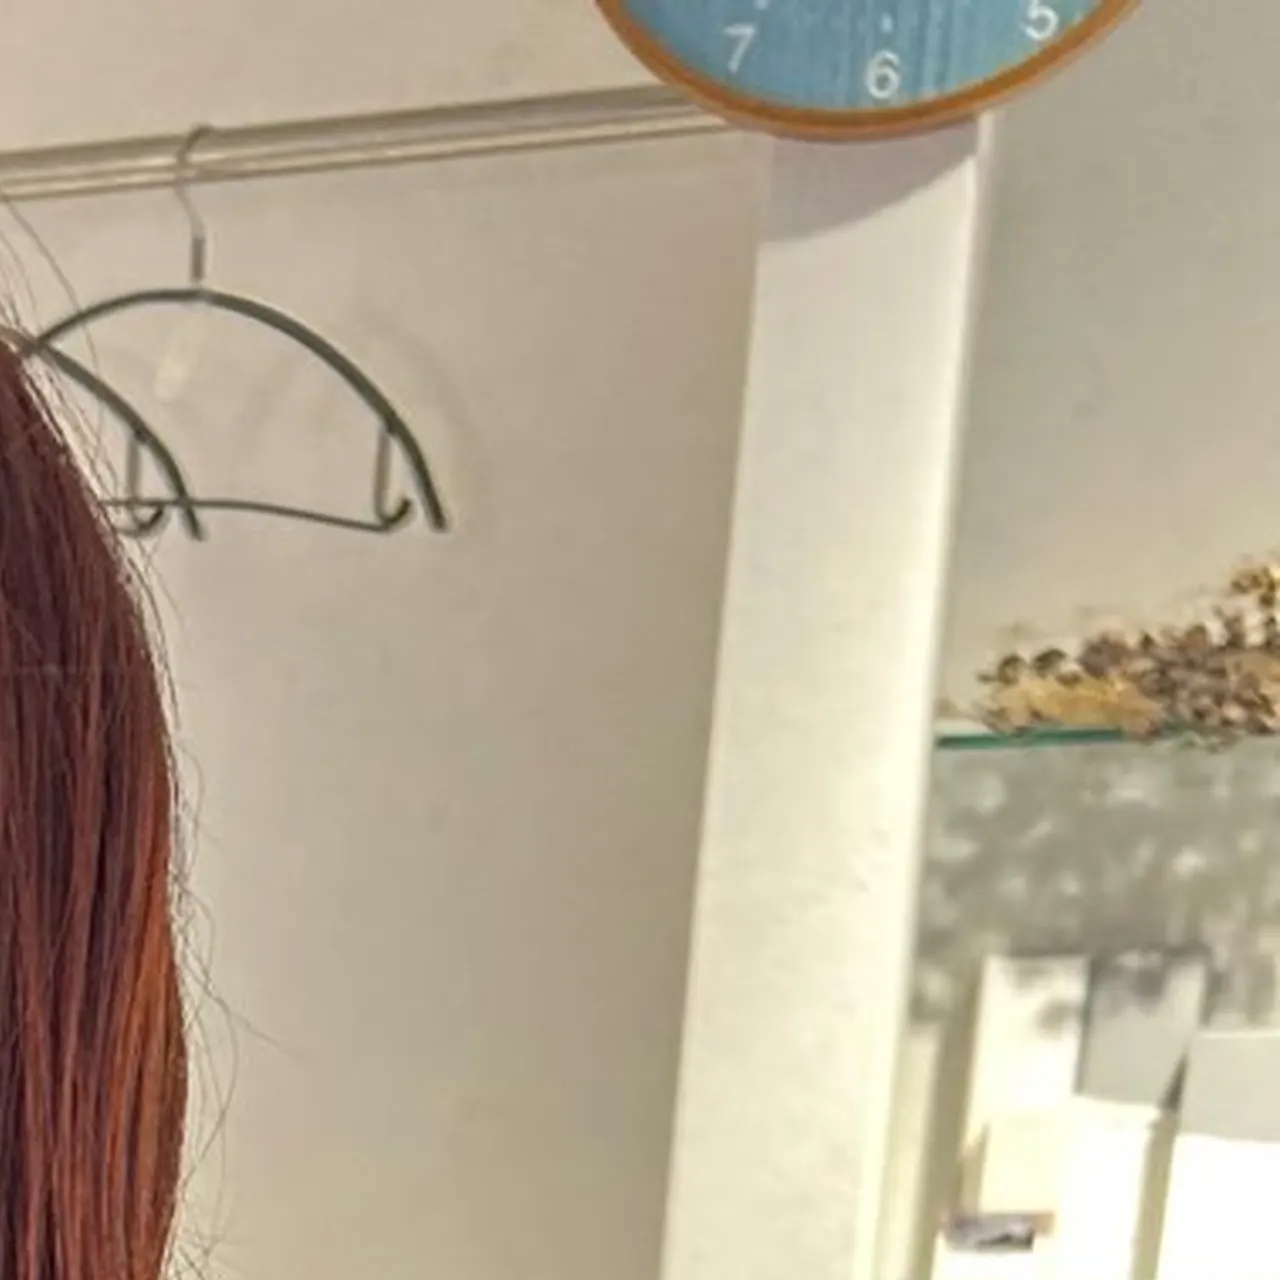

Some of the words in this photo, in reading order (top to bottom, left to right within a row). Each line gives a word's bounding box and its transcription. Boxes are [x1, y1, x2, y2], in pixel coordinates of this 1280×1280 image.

[1024, 0, 1058, 40] 5
[724, 23, 756, 72] 7
[865, 49, 900, 99] 6
